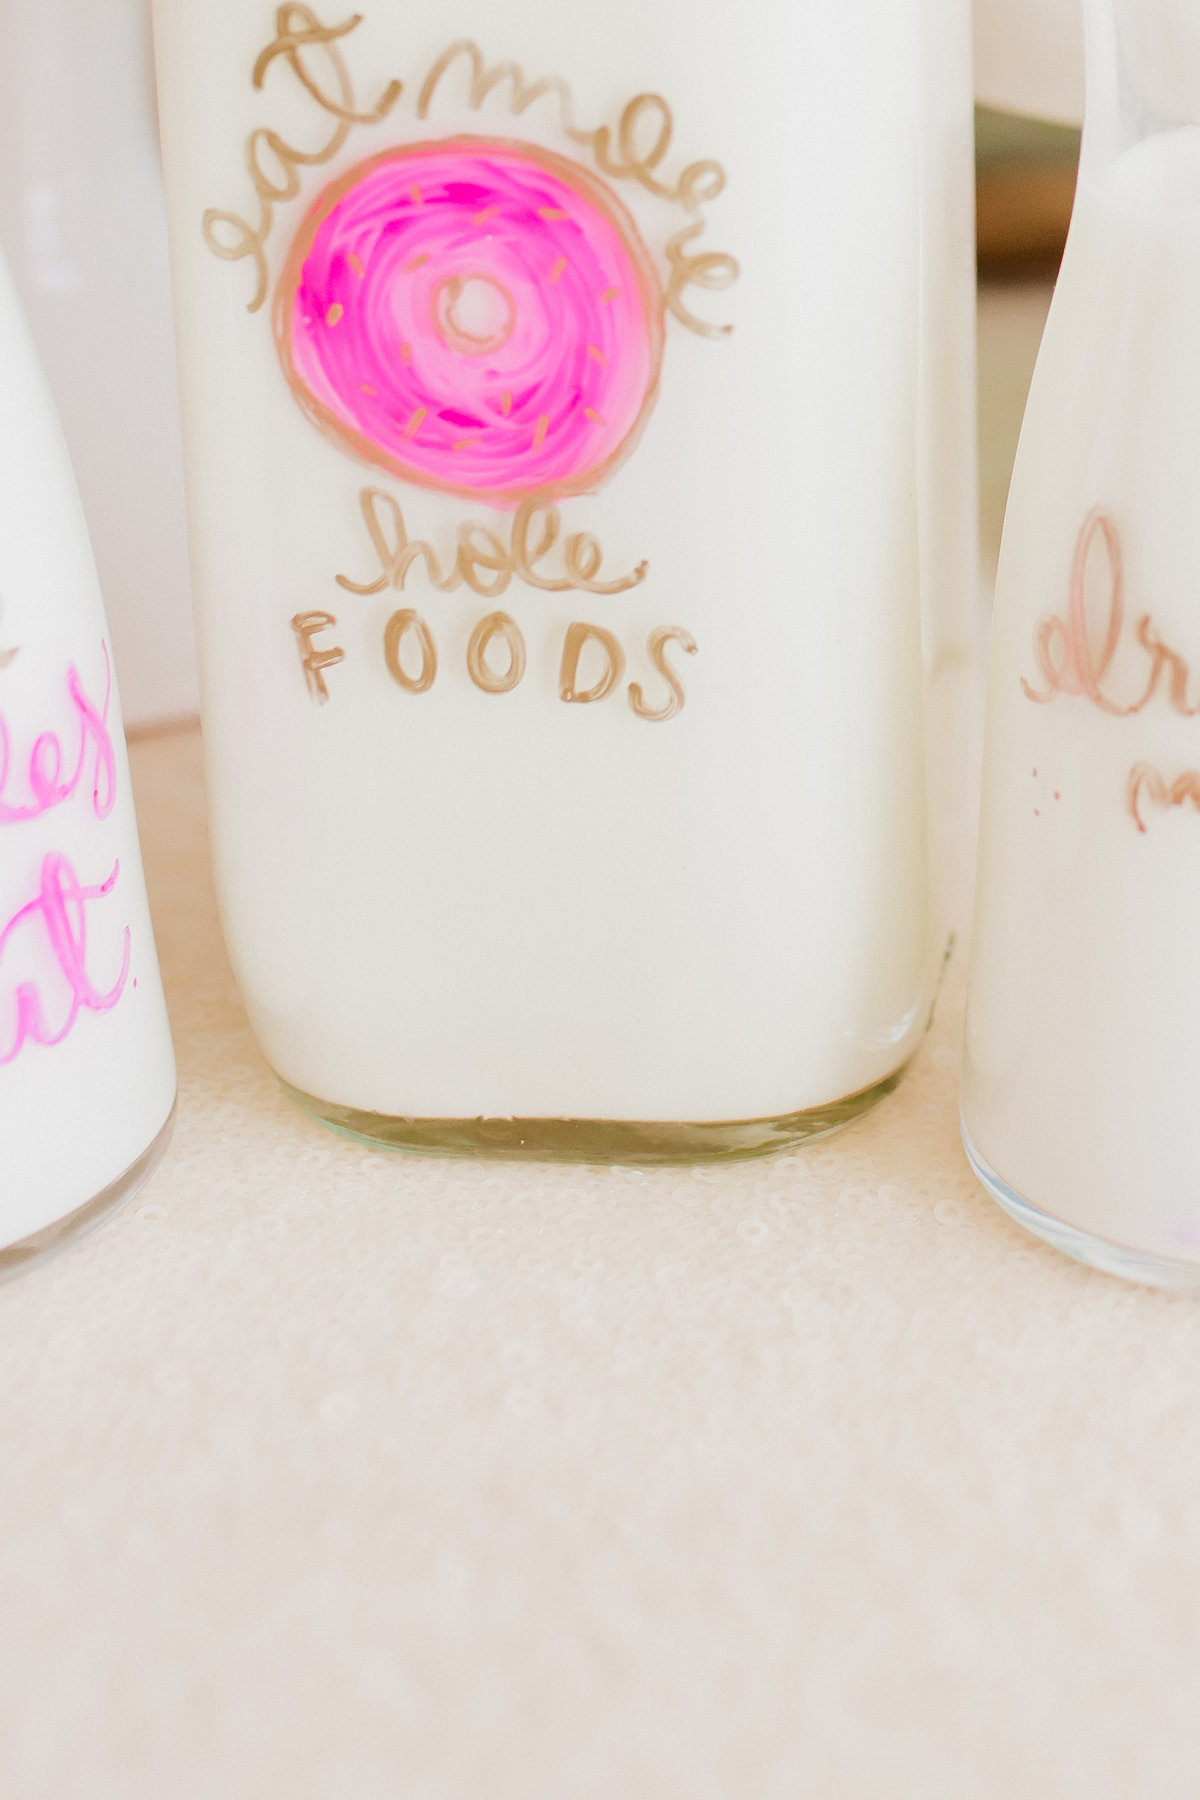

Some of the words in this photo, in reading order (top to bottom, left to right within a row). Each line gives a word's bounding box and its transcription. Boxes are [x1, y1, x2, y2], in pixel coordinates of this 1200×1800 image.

[202, 0, 403, 314] eat
[335, 485, 649, 597] hole
[290, 608, 698, 721] FOODS
